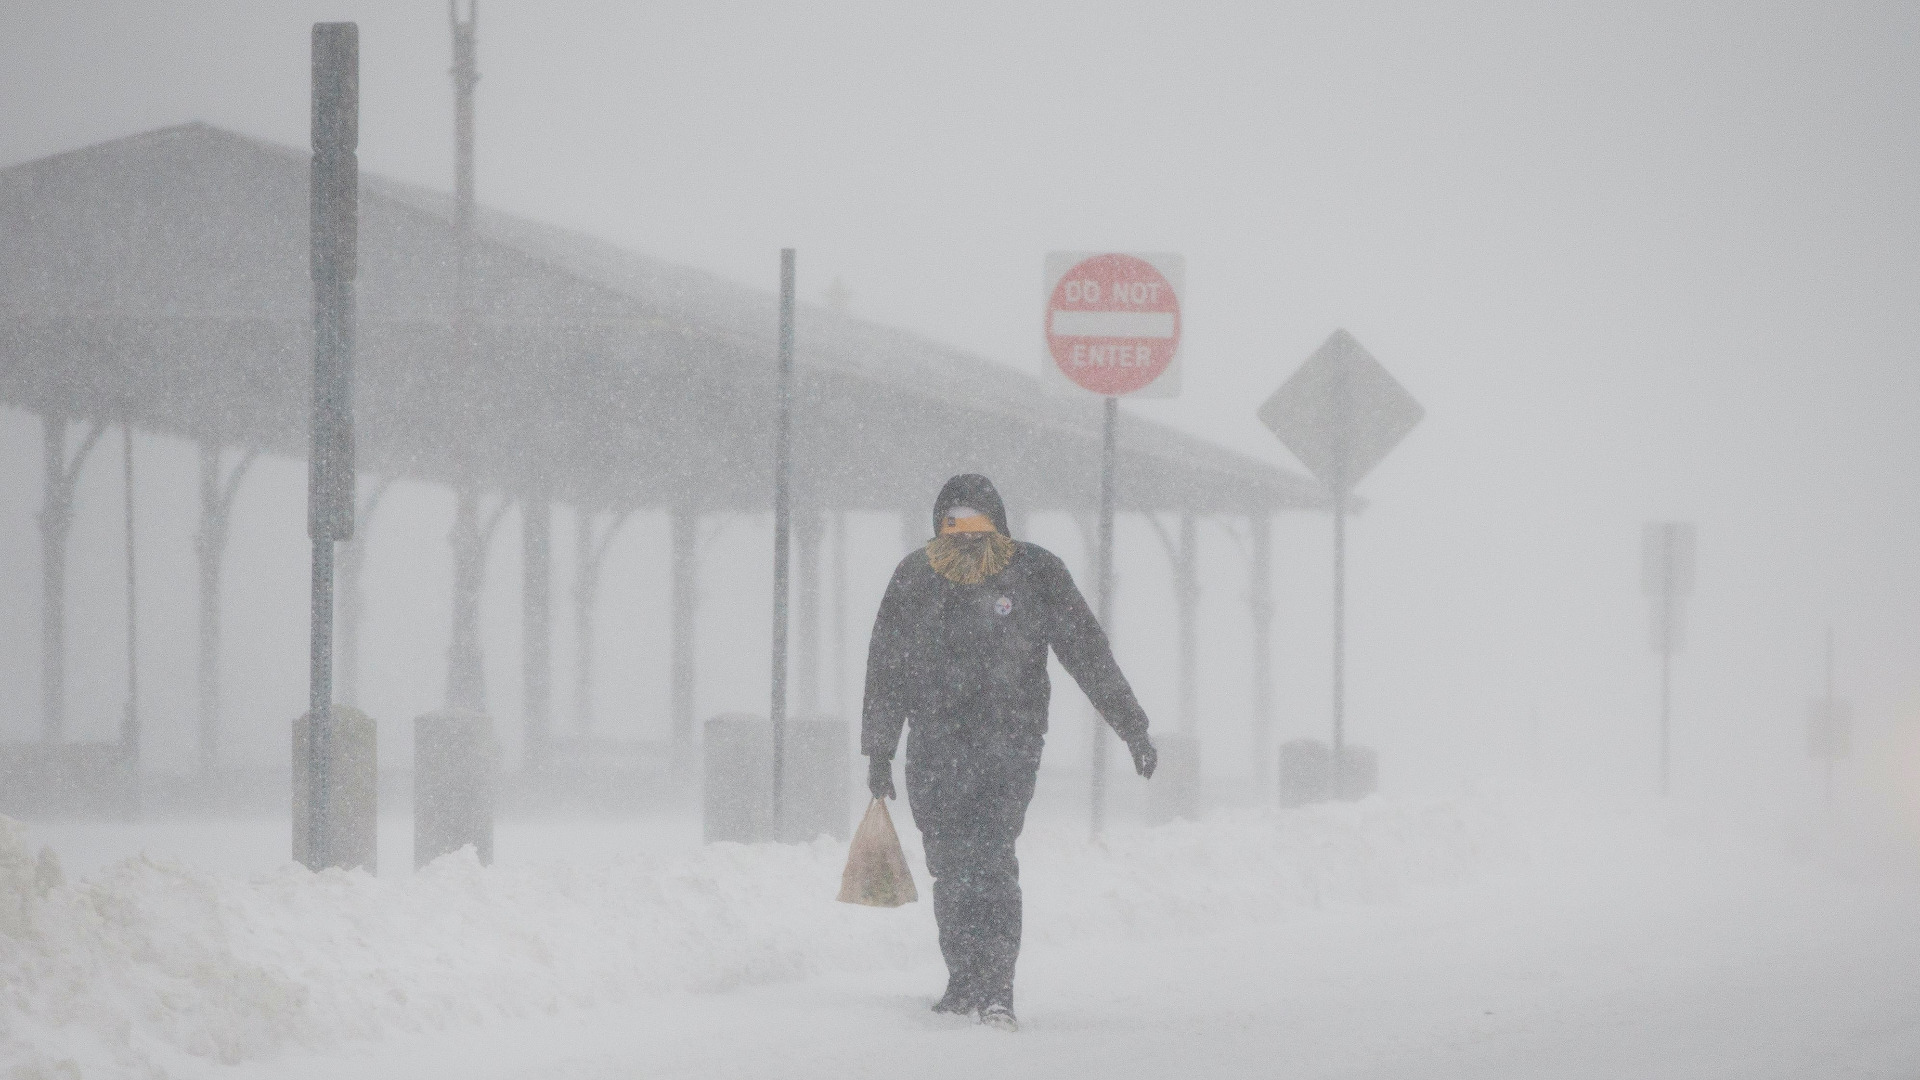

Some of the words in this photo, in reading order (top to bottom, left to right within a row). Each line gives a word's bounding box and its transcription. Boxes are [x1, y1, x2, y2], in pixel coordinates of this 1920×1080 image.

[1065, 280, 1099, 303] DO
[1112, 282, 1160, 304] NOT
[1073, 344, 1150, 367] ENTER
